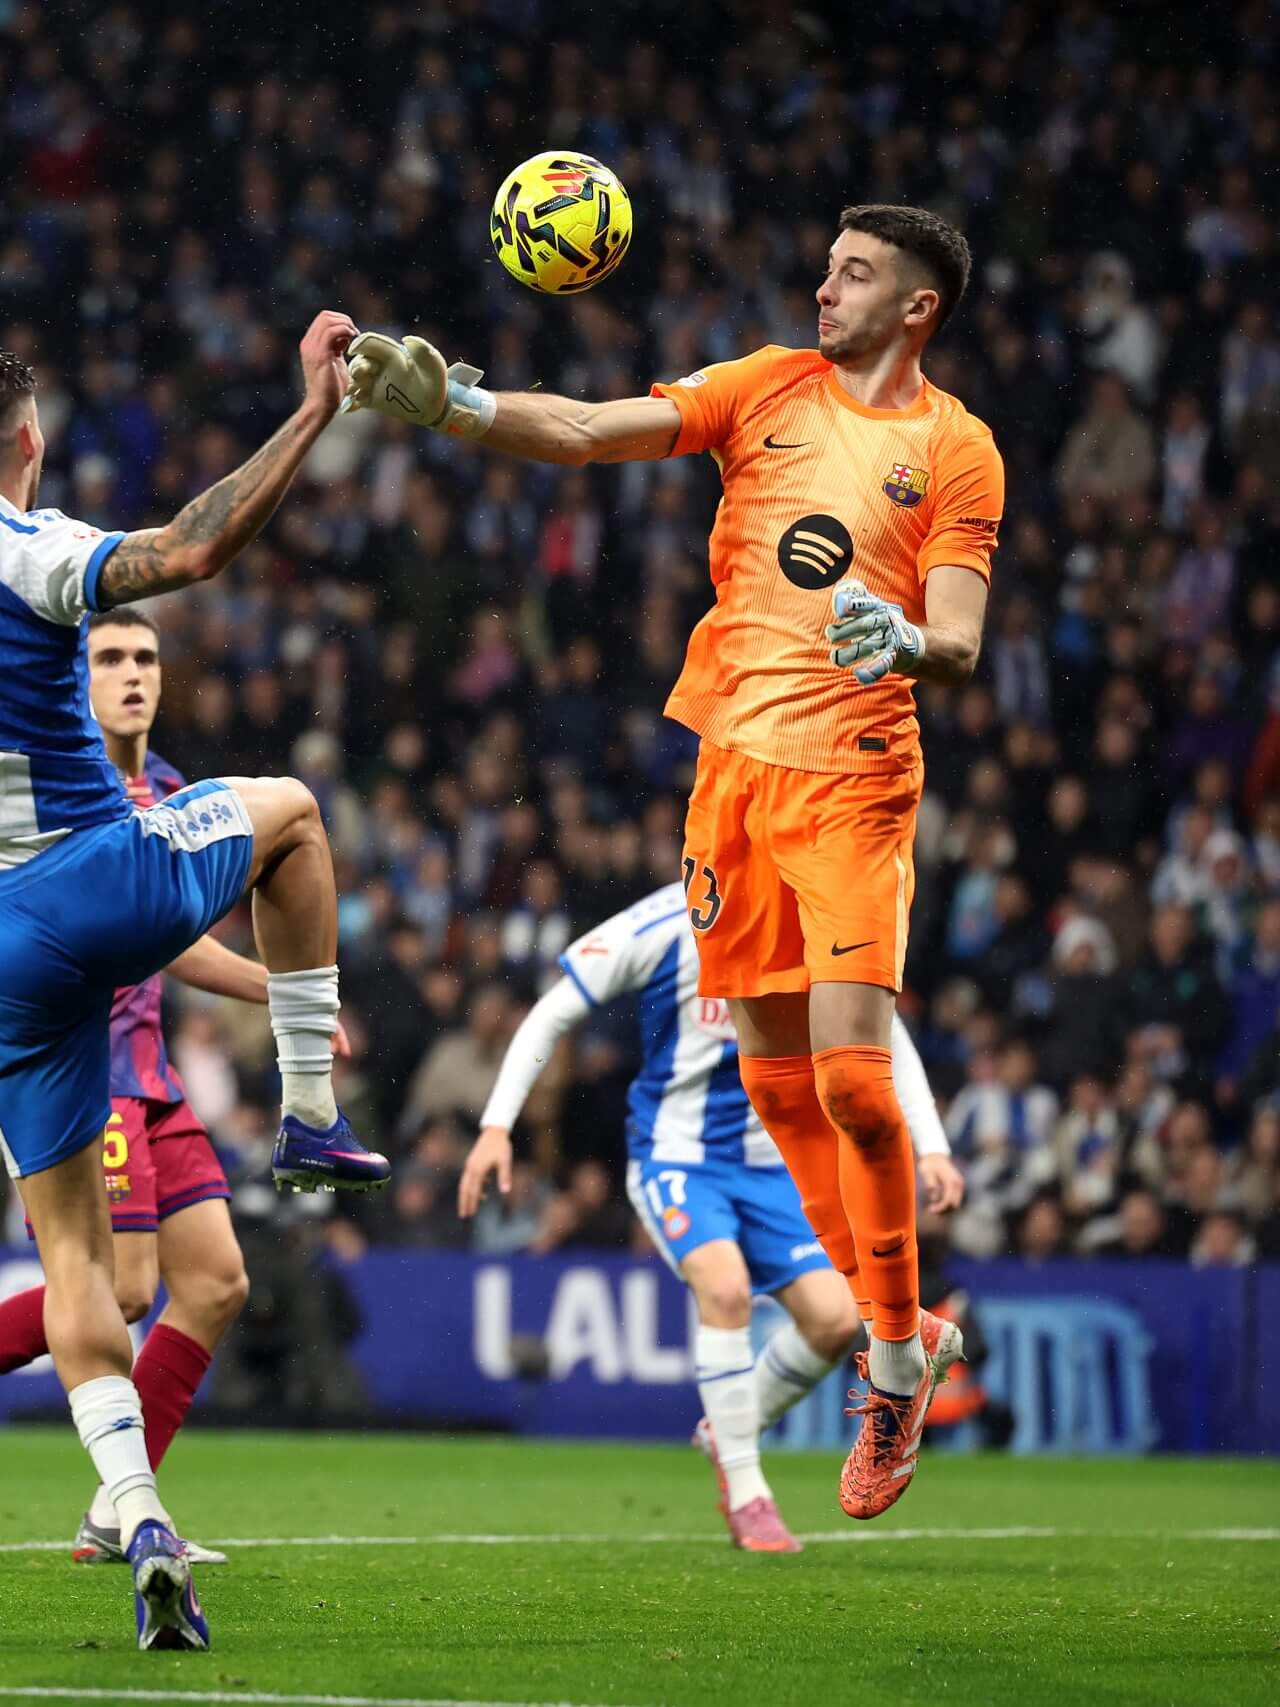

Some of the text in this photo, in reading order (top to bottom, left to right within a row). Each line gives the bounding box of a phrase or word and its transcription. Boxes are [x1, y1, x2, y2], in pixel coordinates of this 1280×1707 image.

[683, 856, 721, 930] 13
[103, 1112, 128, 1169] 5
[646, 1169, 688, 1217] 17
[475, 1266, 696, 1383] LAL
